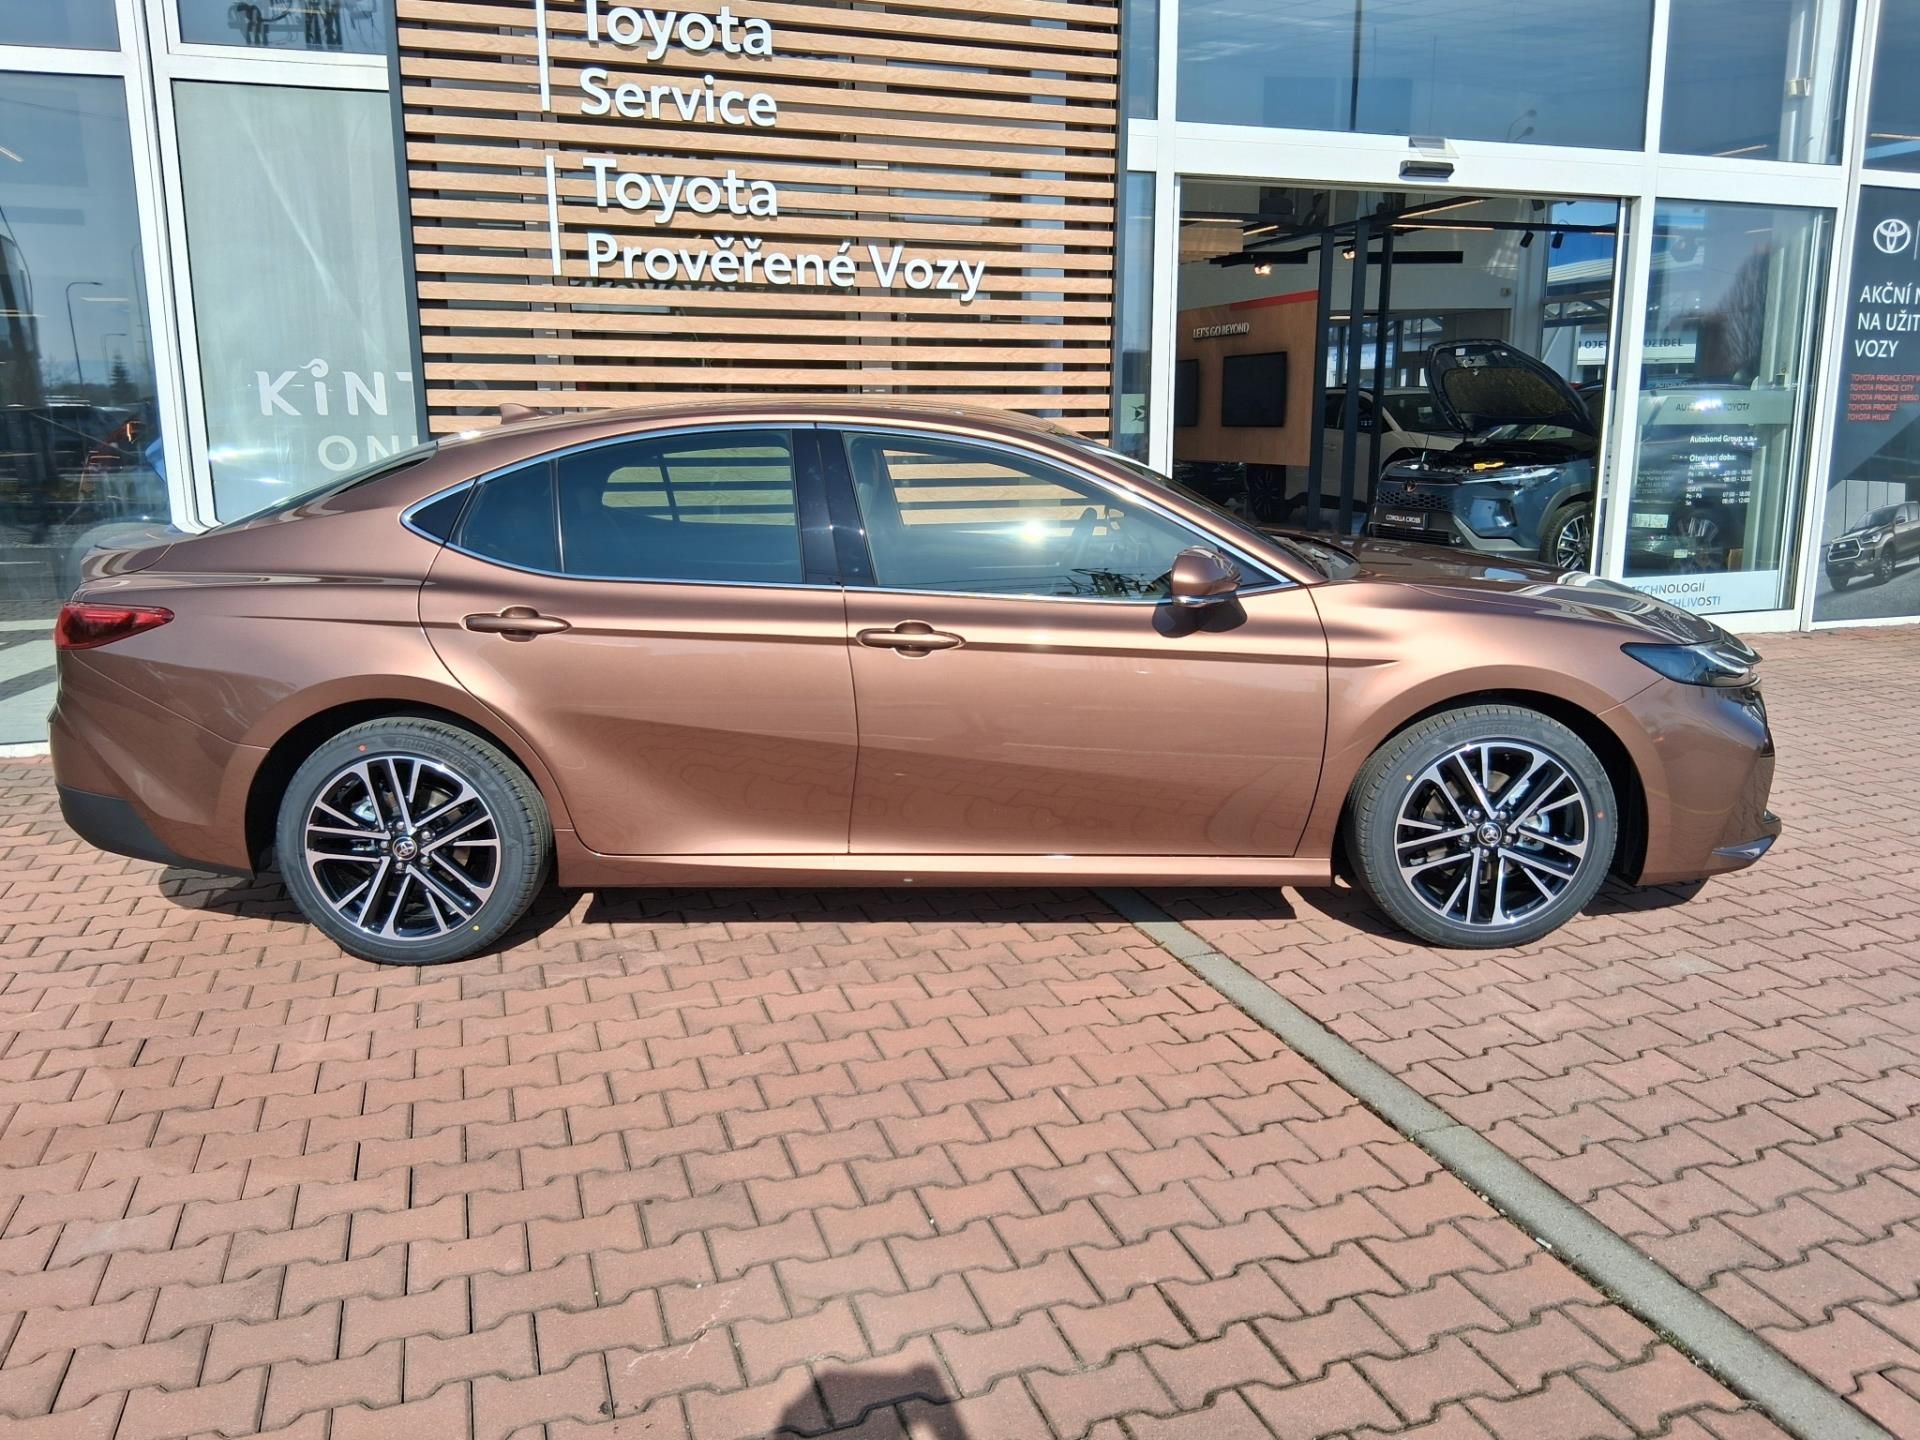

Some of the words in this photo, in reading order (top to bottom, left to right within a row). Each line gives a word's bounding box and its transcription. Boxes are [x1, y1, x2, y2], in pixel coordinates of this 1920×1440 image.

[586, 0, 773, 61] Toyota
[580, 67, 777, 127] Service
[583, 157, 778, 223] Toyota
[587, 232, 856, 288] Prověřené
[868, 244, 986, 302] Vozy
[1860, 281, 1913, 305] AKČNÍ
[1210, 325, 1221, 337] GO
[1221, 322, 1250, 336] BEYOND
[1857, 312, 1881, 331] NA
[1585, 340, 1608, 349] OJE
[1854, 339, 1899, 358] VOZY
[1689, 434, 1721, 444] Autobond
[1722, 433, 1743, 445] Group
